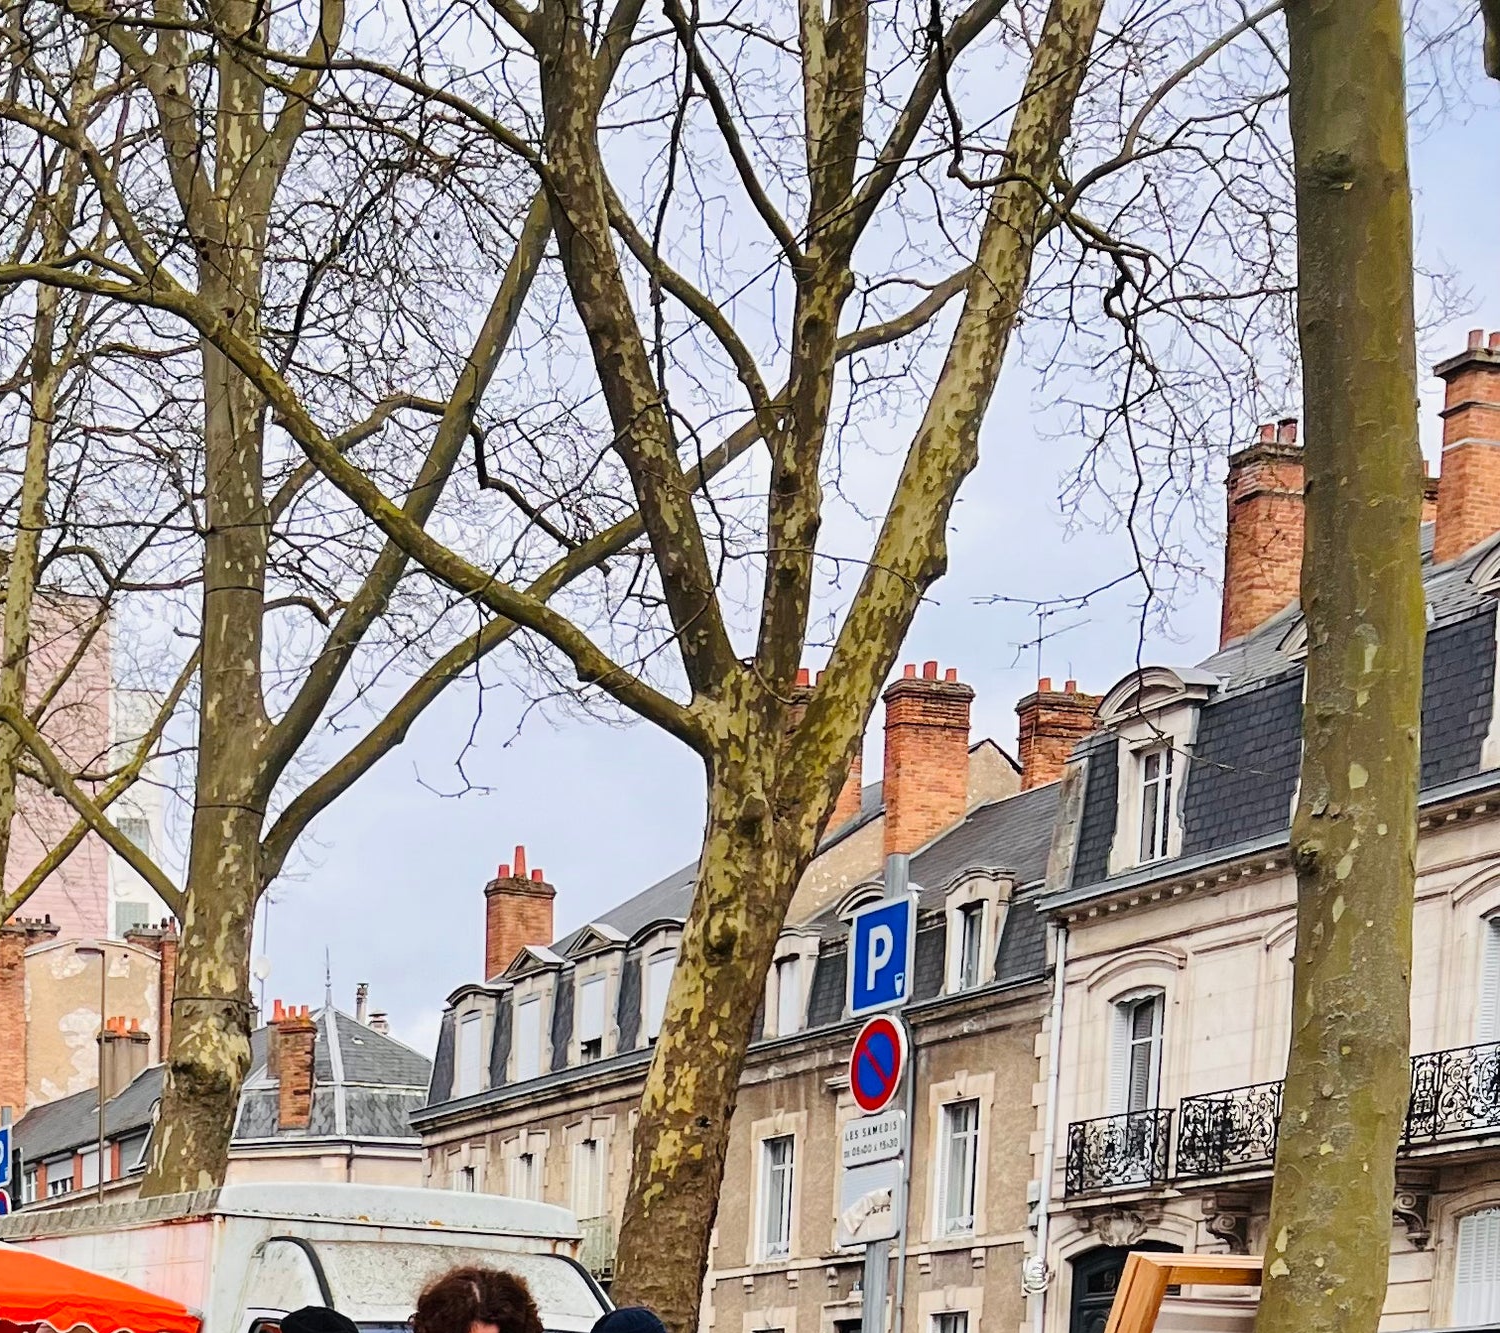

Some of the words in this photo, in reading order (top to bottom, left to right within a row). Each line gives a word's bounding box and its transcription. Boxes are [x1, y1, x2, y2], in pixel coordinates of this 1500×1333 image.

[866, 924, 894, 991] P
[844, 1129, 859, 1141] LES
[862, 1120, 897, 1137] SAMEDIS
